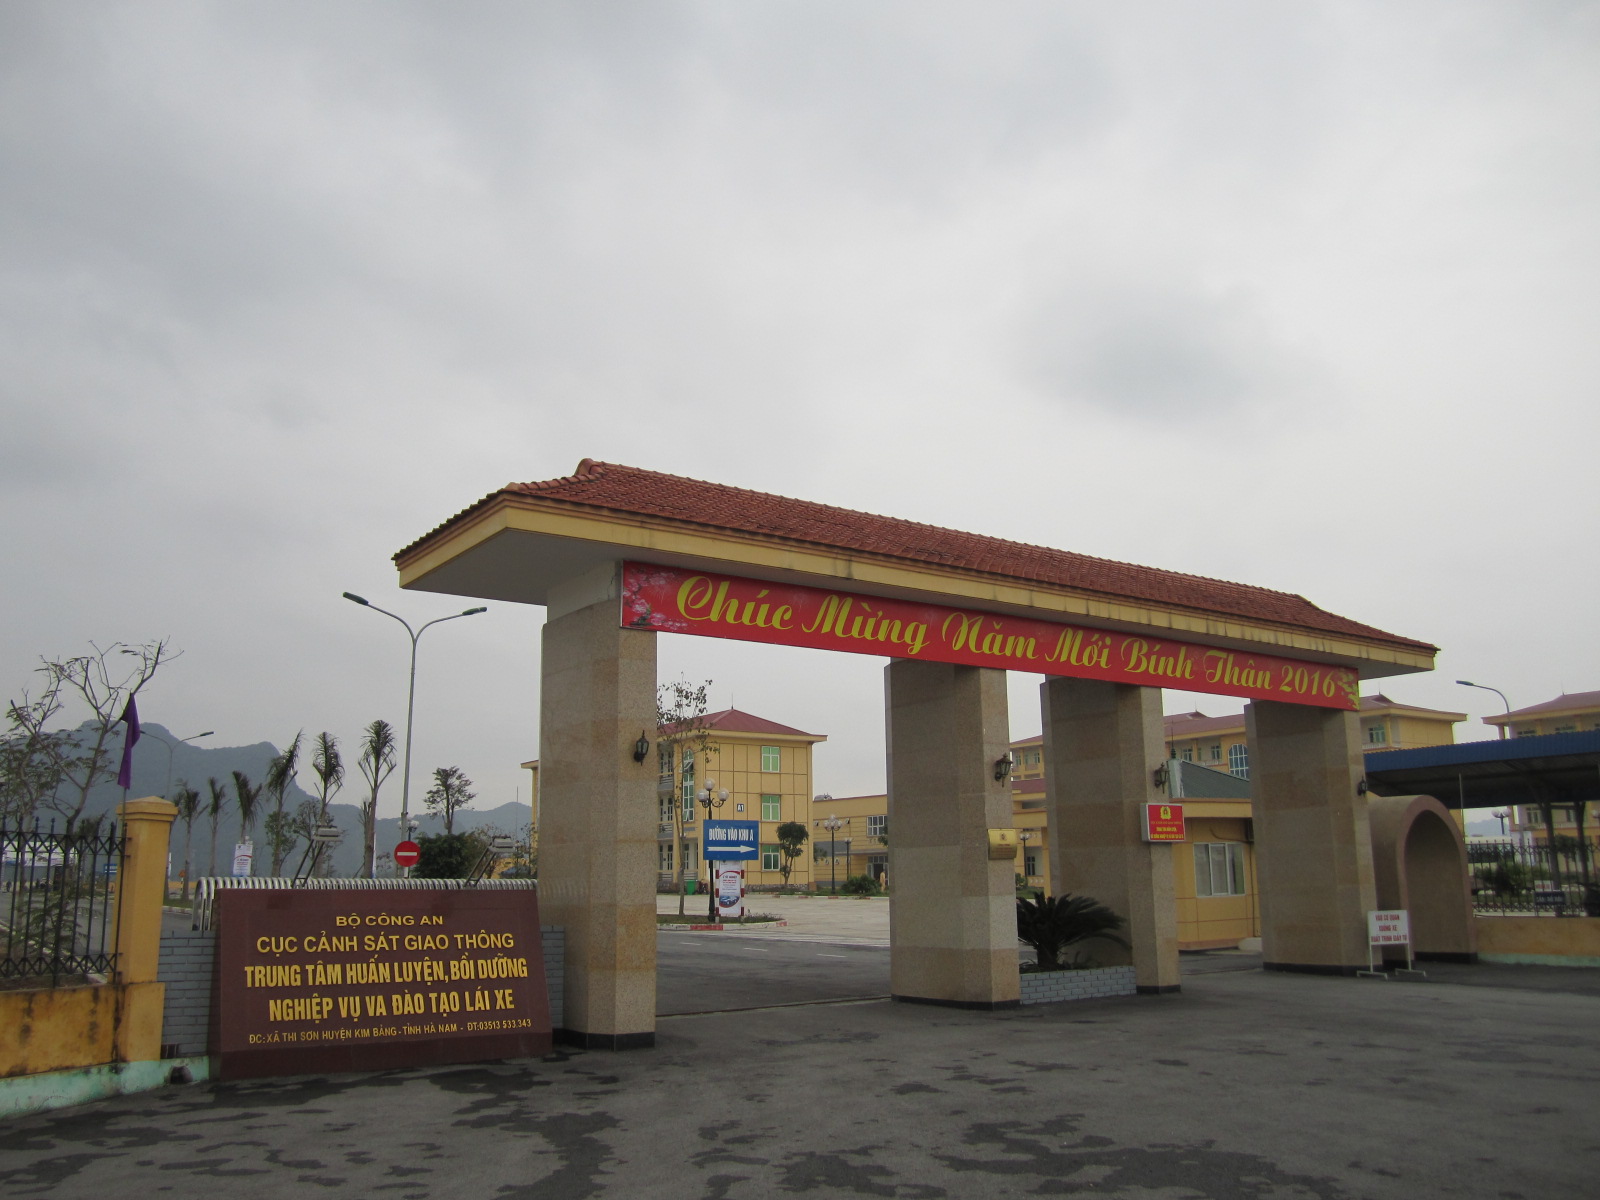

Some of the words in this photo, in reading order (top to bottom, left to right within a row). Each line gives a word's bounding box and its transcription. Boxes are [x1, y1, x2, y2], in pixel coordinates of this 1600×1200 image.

[676, 575, 793, 630] Chúc
[801, 594, 930, 654] Mừng
[942, 611, 1039, 659] Năm
[1045, 627, 1111, 668] Mới
[1120, 637, 1194, 679] Bính
[1203, 650, 1273, 690] Thân
[1279, 664, 1336, 698] 2016
[708, 826, 726, 840] ĐƯỜNG
[728, 827, 738, 840] VÀO
[739, 829, 749, 840] KHU
[750, 829, 754, 840] A
[336, 912, 360, 929] BỘ
[365, 912, 415, 926] CÔNG
[420, 915, 443, 926] AN
[256, 936, 298, 957] CỤC
[304, 930, 358, 953] CẢNH
[364, 931, 400, 951] SÁT
[404, 934, 450, 951] GIAO
[454, 929, 514, 950] THÔNG
[244, 964, 302, 988] TRUNG
[306, 960, 342, 986] TÂM
[346, 954, 390, 985] HUẤN
[394, 956, 449, 986] LUYỆN,
[450, 952, 476, 980] BỒI
[477, 952, 528, 979] DƯỠNG
[268, 992, 334, 1024] NGHIỆP
[338, 996, 361, 1022] VỤ
[365, 995, 387, 1017] VA
[392, 989, 425, 1016] ĐÀO
[428, 991, 460, 1018] TẠO
[464, 986, 491, 1012] LÁI
[494, 988, 515, 1010] XE
[282, 1032, 297, 1042] THI
[300, 1030, 320, 1041] SƠN
[322, 1028, 352, 1042] HUYỆN
[354, 1028, 370, 1038] KIM
[373, 1024, 397, 1038] BẢNG
[403, 1022, 422, 1036] TỈNH
[424, 1022, 436, 1034] HÀ
[438, 1024, 458, 1033] NAM
[502, 1018, 532, 1029] 533.343
